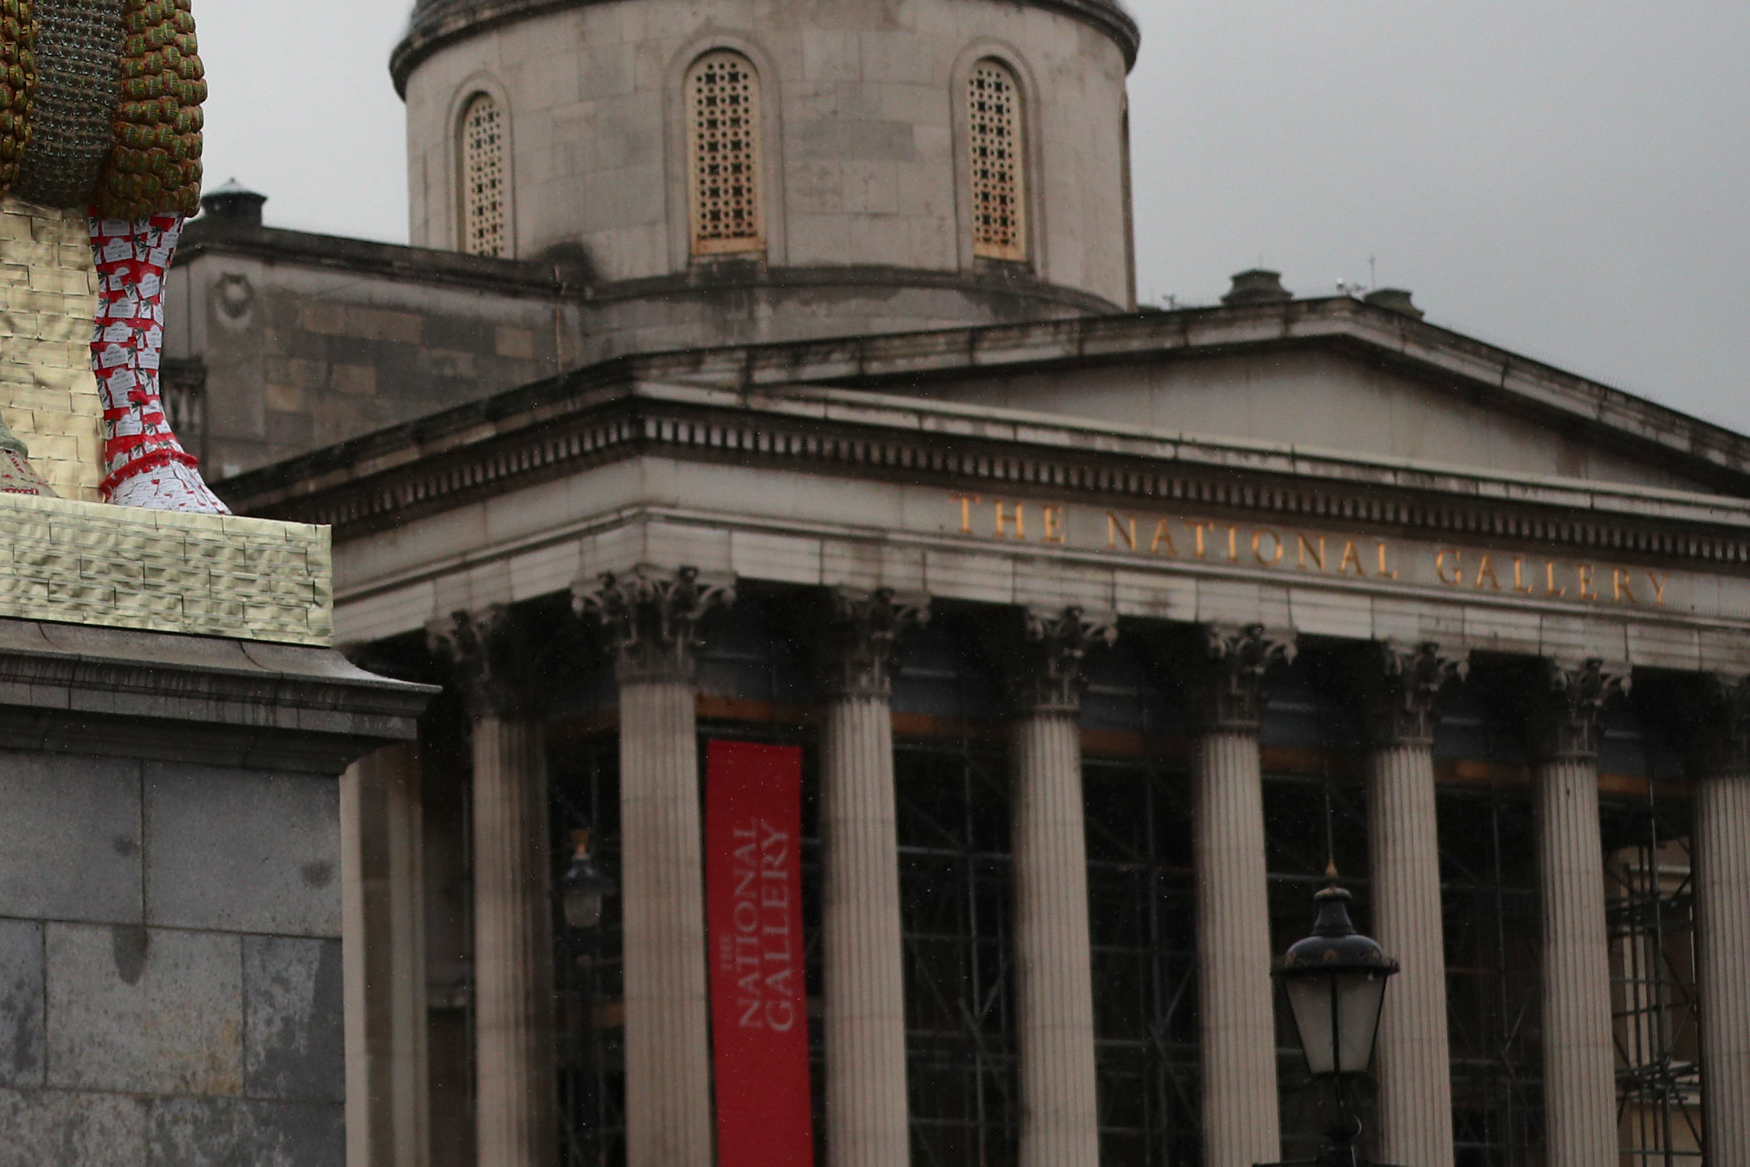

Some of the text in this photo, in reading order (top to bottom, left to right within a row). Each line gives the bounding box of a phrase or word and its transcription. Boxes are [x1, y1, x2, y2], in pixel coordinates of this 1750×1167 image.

[951, 495, 1670, 606] THE NATIONAL GALLERY
[720, 935, 733, 975] THE
[734, 818, 762, 1029] NATIONAL
[761, 820, 795, 1033] GALLERY
